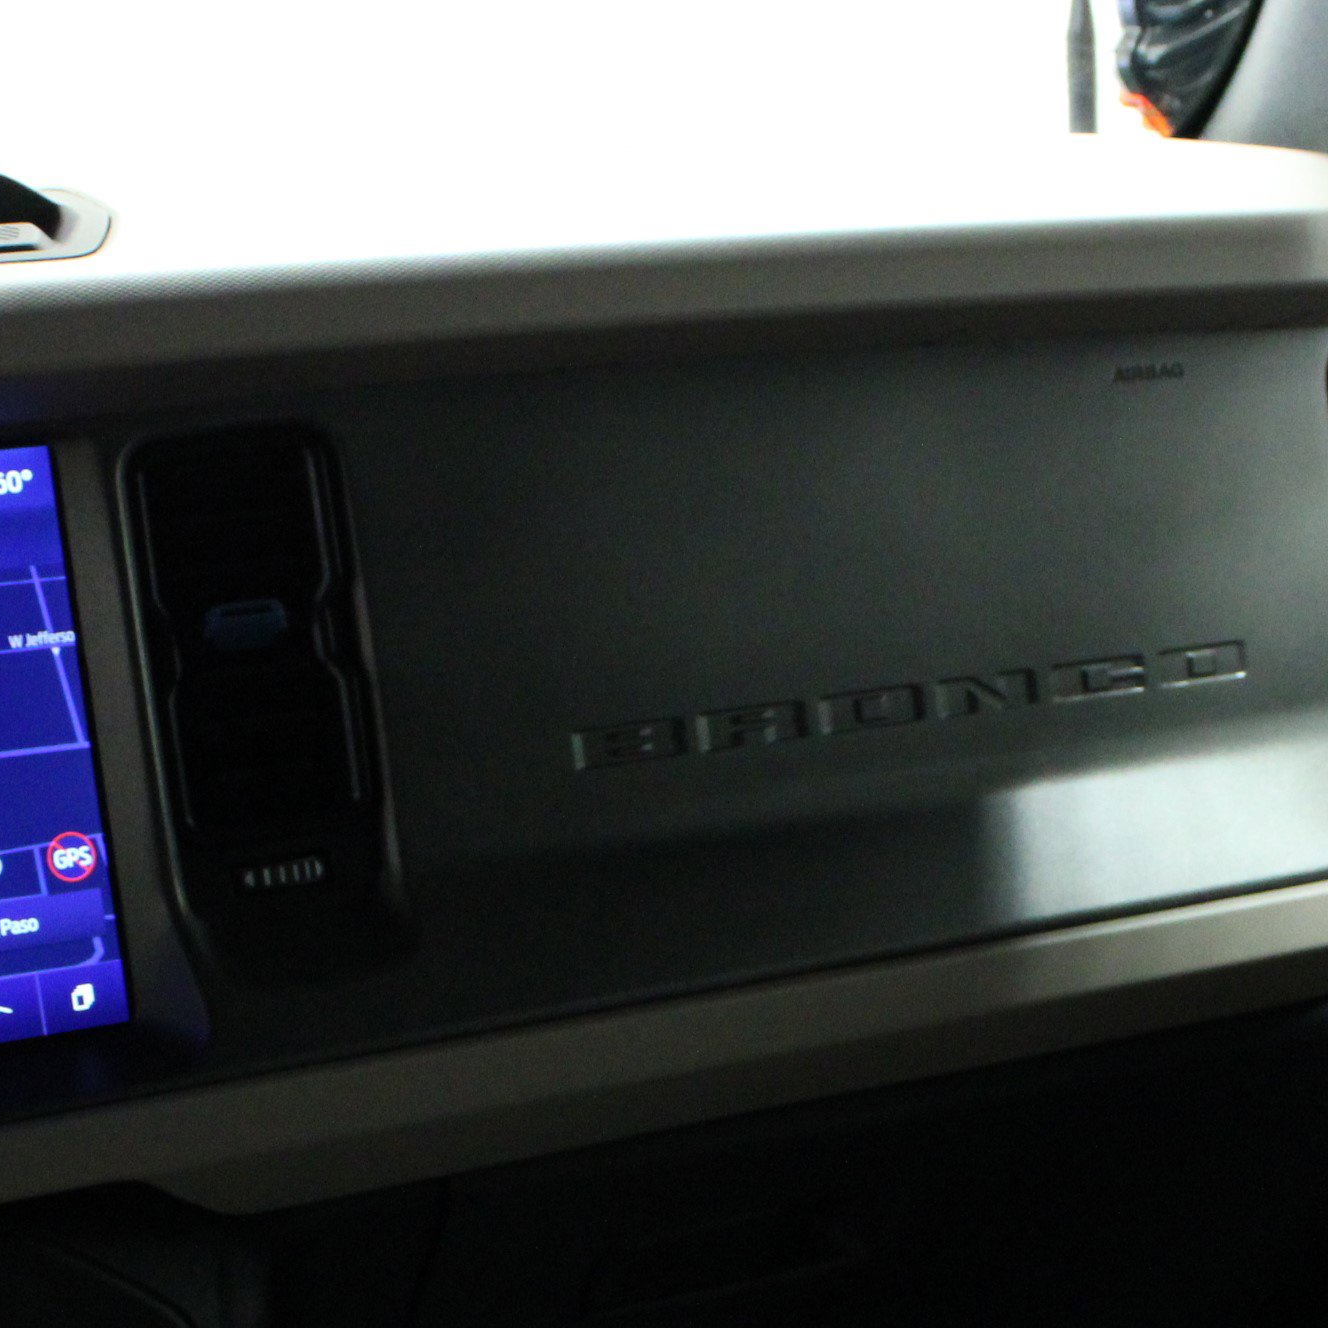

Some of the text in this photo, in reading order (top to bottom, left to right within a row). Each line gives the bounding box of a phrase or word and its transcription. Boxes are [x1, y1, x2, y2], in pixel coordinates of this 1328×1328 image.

[7, 634, 23, 649] W
[571, 638, 1248, 772] BRONCO
[53, 845, 93, 870] GPS
[0, 915, 40, 937] Paso
